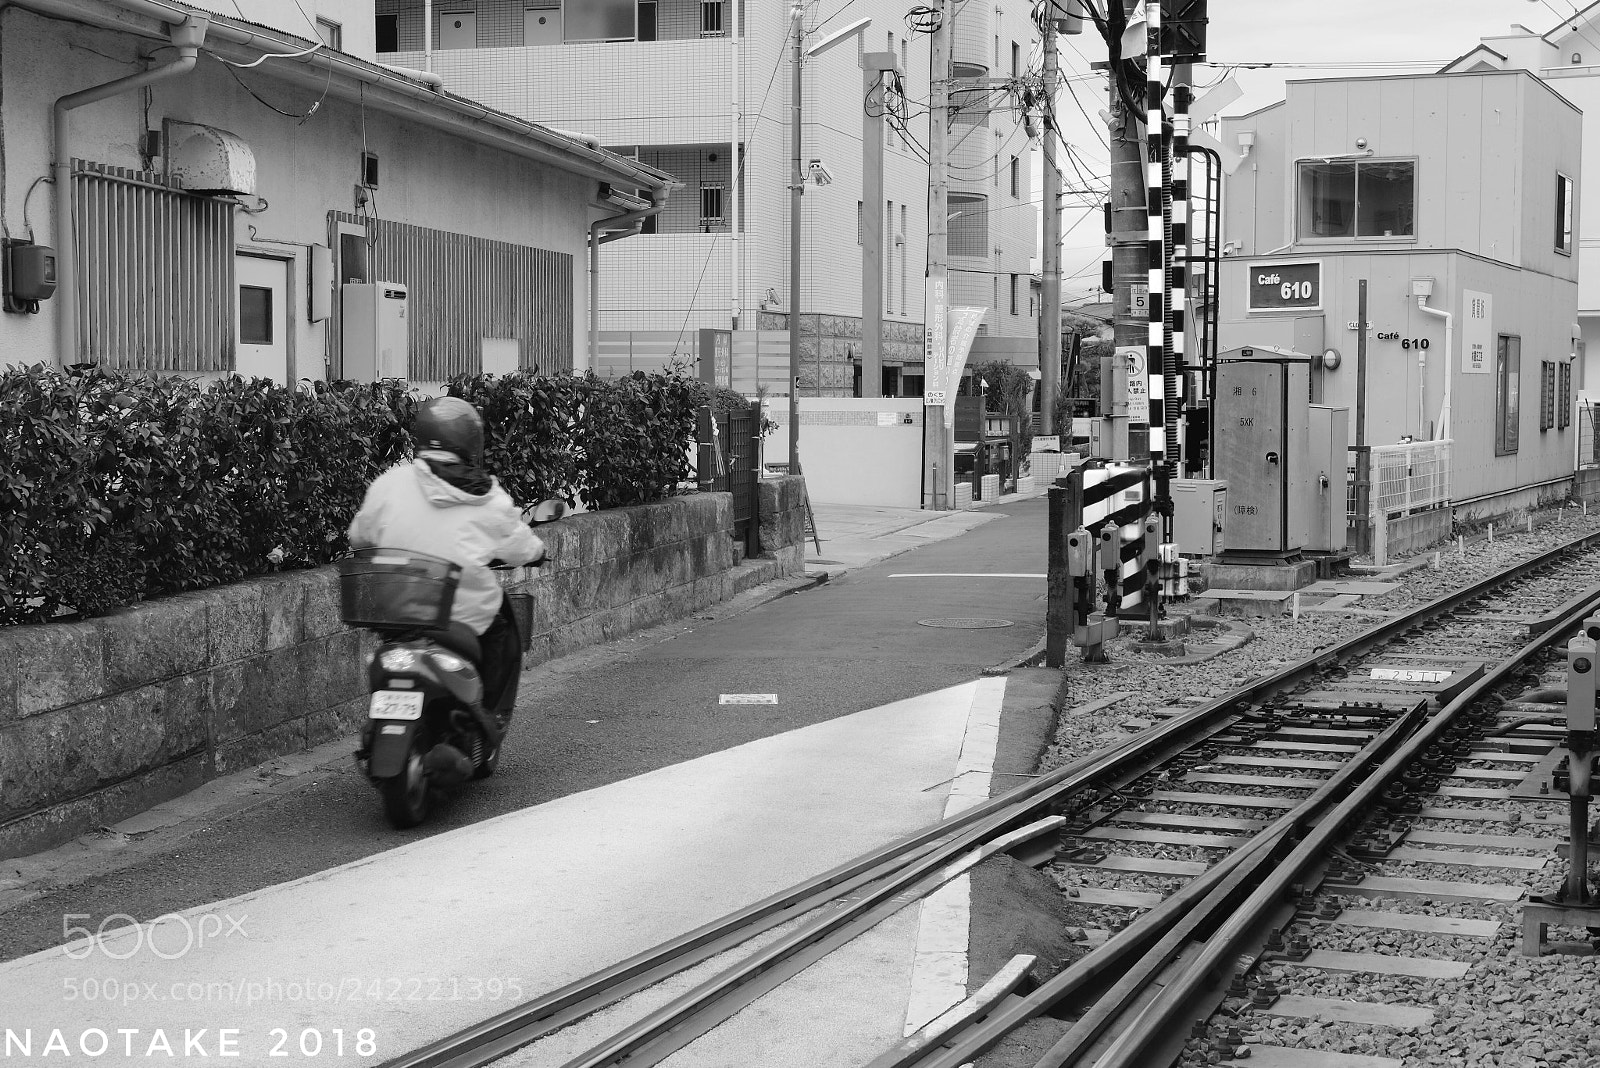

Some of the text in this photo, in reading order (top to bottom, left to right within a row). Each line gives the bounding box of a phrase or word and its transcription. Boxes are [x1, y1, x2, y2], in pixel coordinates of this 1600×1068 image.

[1258, 274, 1281, 285] Café
[1280, 281, 1312, 299] 610
[1136, 296, 1145, 307] 5
[1377, 332, 1400, 340] Café
[1401, 338, 1430, 349] 610
